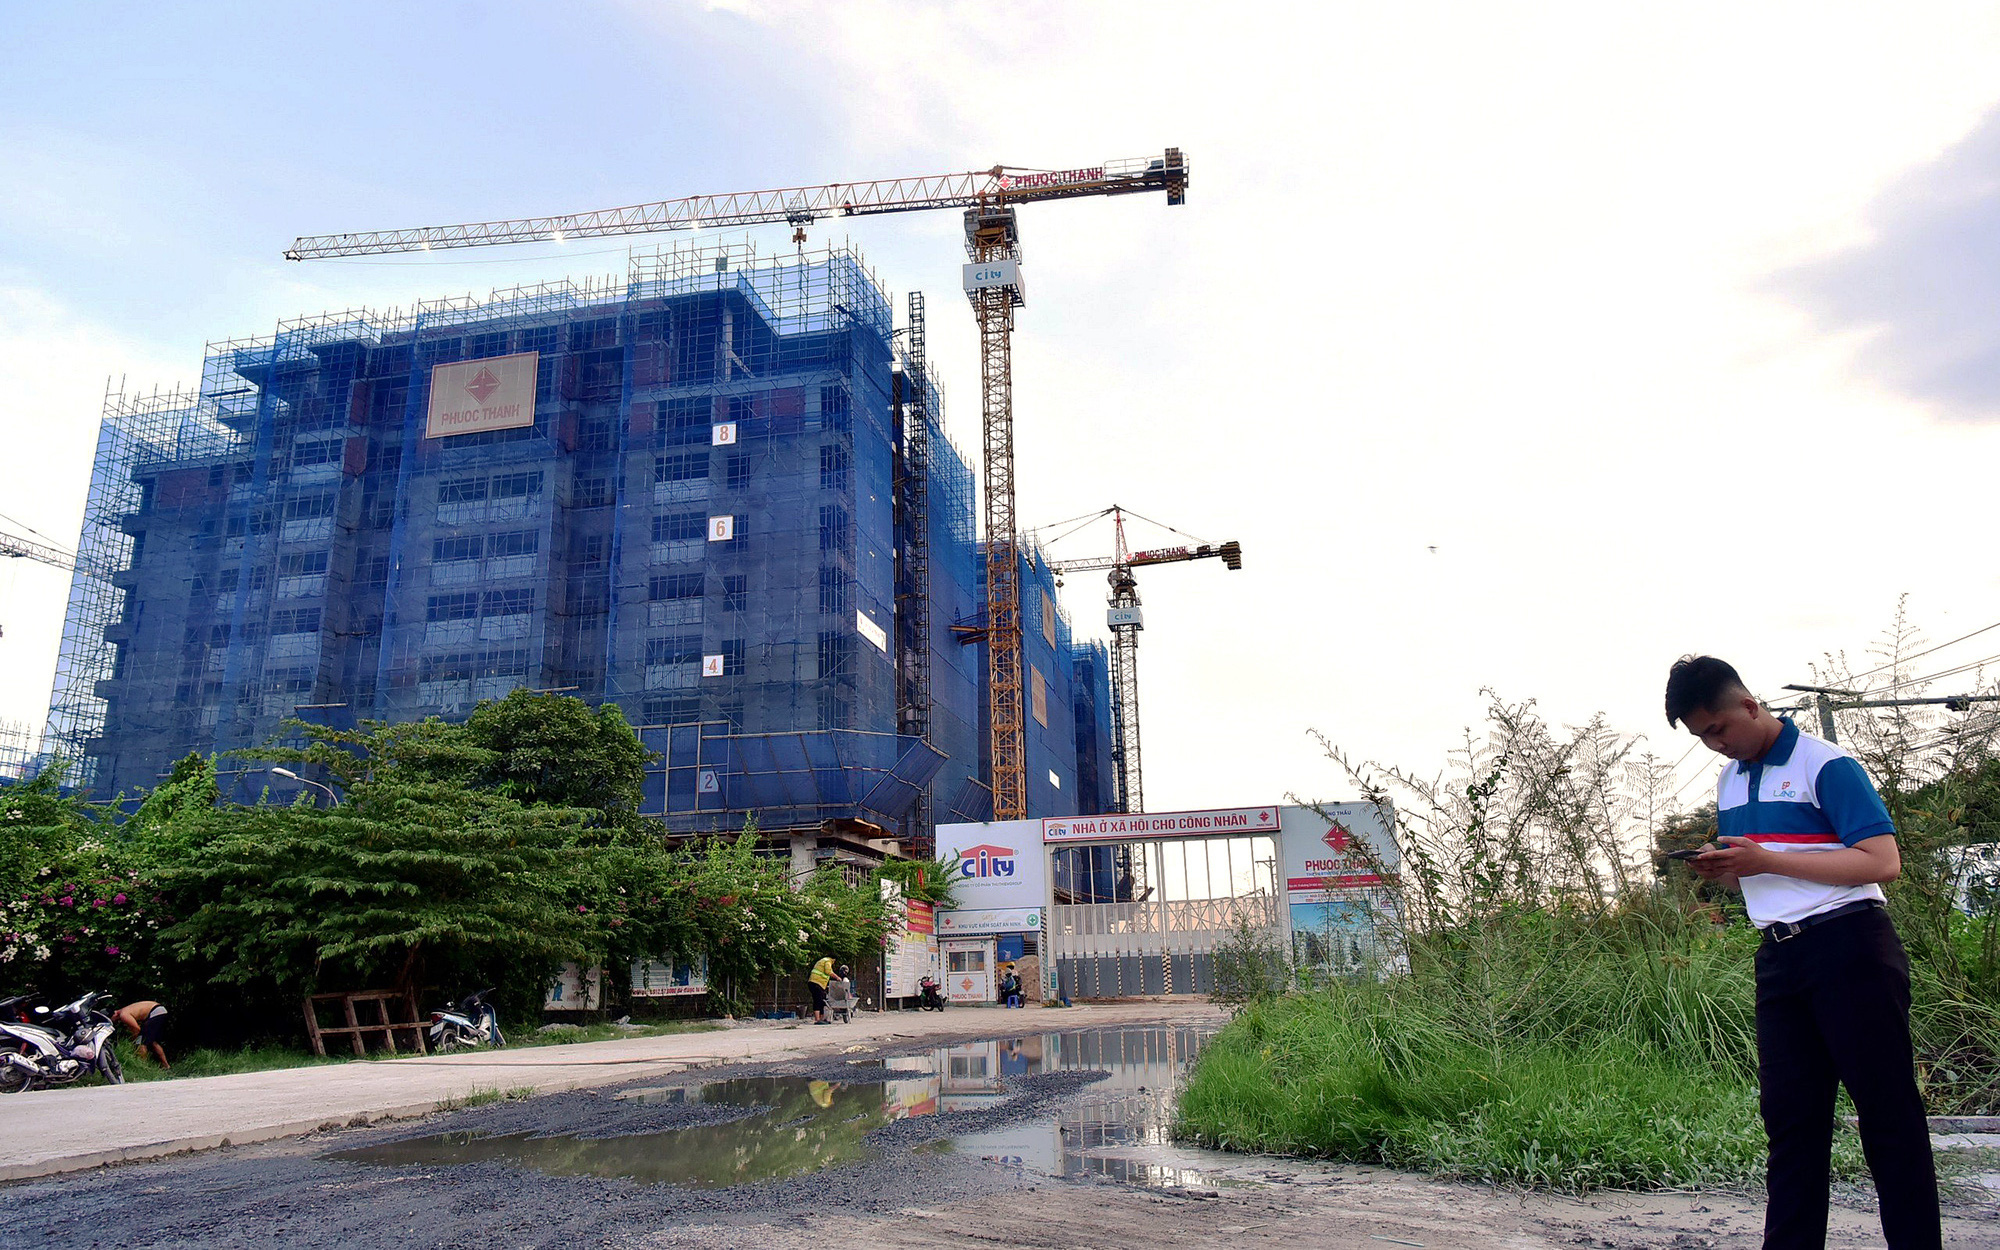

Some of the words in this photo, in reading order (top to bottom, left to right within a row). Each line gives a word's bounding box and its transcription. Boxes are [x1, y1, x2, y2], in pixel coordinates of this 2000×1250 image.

[1063, 166, 1103, 182] THANH
[441, 409, 479, 426] PHUOC
[482, 404, 519, 420] THANH
[720, 425, 729, 441] 8
[716, 520, 726, 537] 6
[708, 658, 717, 671] 4
[704, 774, 712, 789] 2
[1072, 821, 1096, 834] NHÀ
[1100, 819, 1107, 833] Ở
[1111, 819, 1126, 832] XÃ
[1130, 818, 1149, 833] HỘI
[1152, 819, 1176, 830] CHO
[1180, 816, 1211, 829] CÔNG
[1214, 813, 1247, 827] NHÂN
